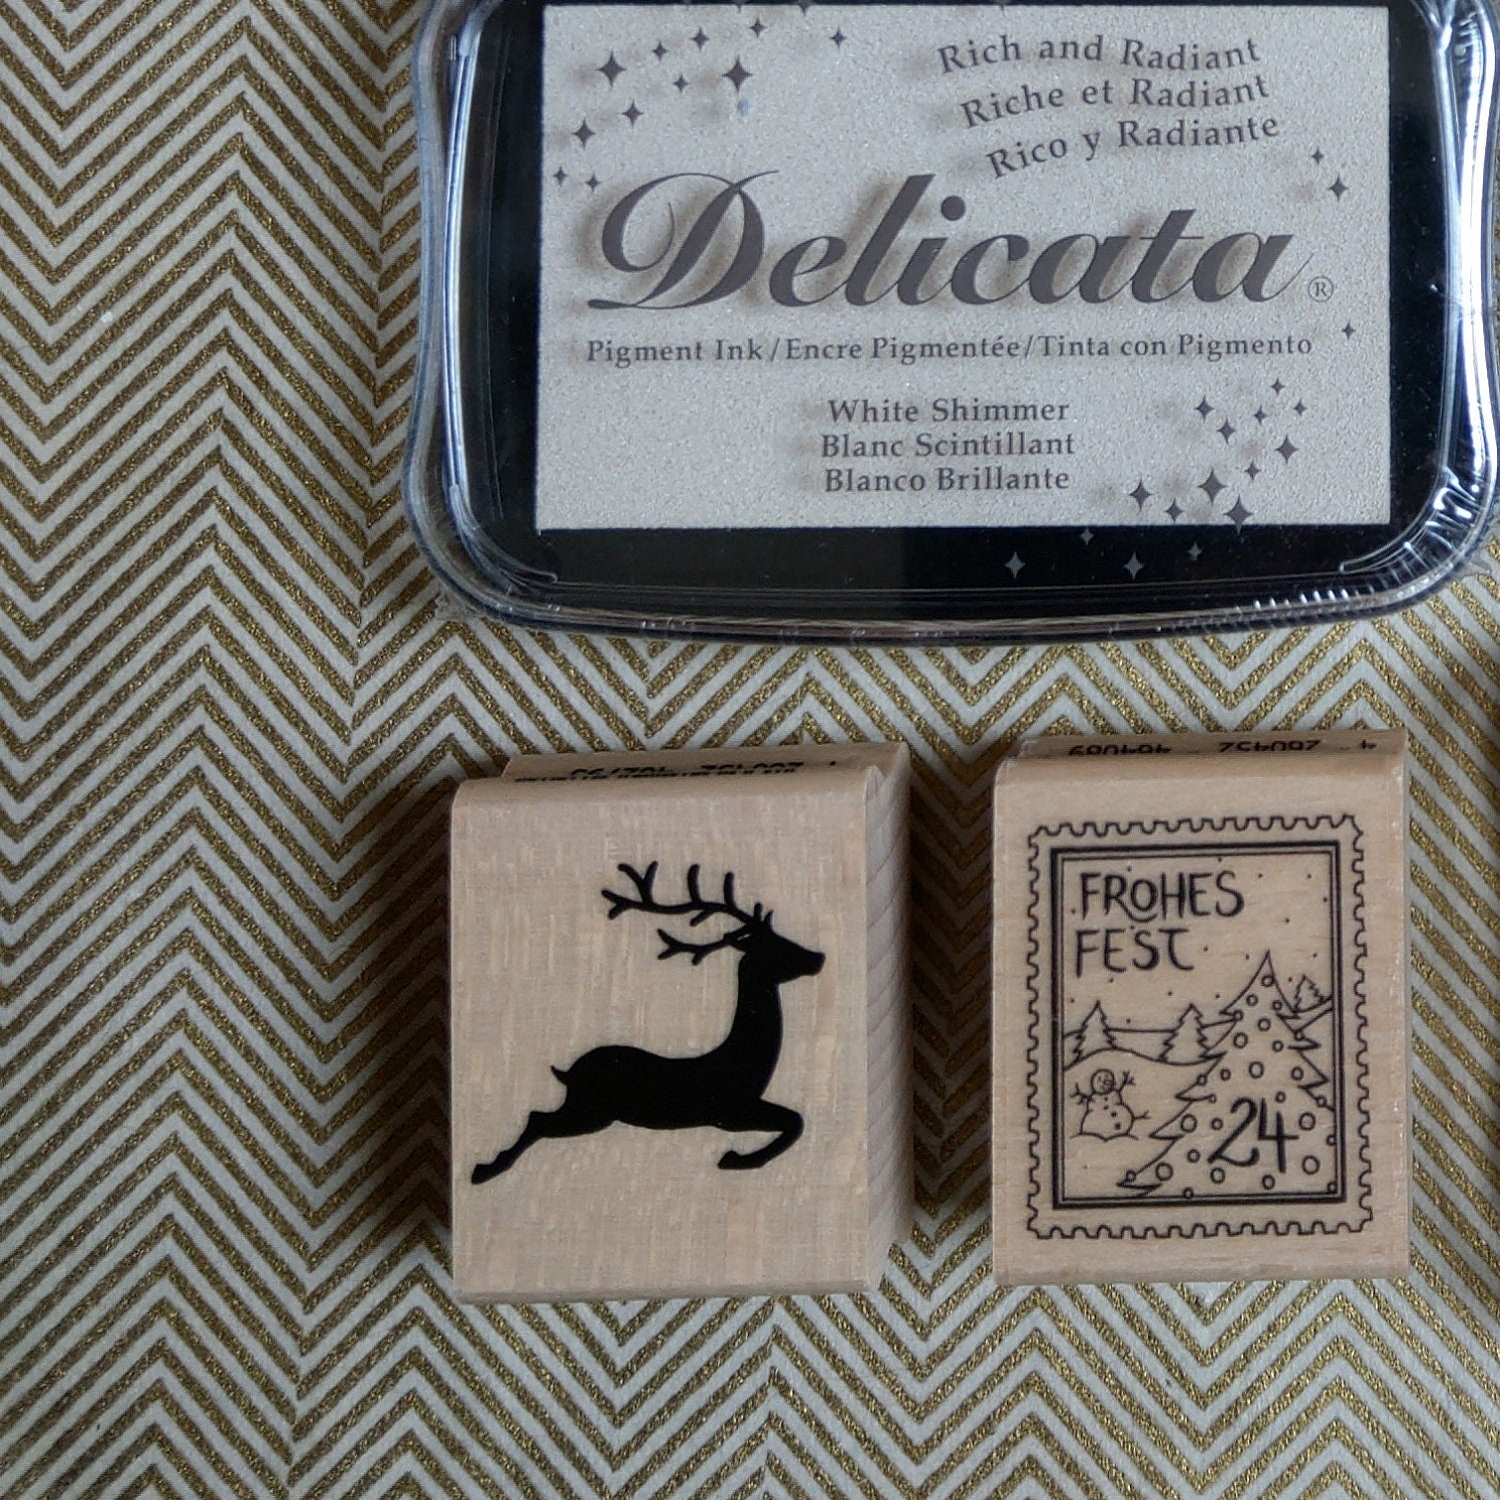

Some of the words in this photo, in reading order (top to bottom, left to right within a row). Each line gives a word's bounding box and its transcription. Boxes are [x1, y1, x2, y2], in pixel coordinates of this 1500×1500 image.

[937, 35, 1022, 74] Rich
[1038, 35, 1104, 62] and
[1120, 37, 1261, 70] Radiant
[960, 84, 1065, 129] Riche
[1081, 80, 1114, 105] et
[1130, 74, 1270, 108] Radiant
[986, 136, 1068, 179] Rico
[1082, 131, 1101, 161] y
[1117, 117, 1280, 148] Radiante
[587, 339, 702, 368] Pigment
[1120, 340, 1167, 357] con
[1177, 333, 1313, 362] Pigmento
[828, 399, 919, 423] White
[932, 398, 1070, 423] Shimmer
[821, 433, 903, 458] Blanc
[915, 431, 1076, 457] Scintillant
[825, 468, 926, 492] Blanco
[937, 466, 1070, 491] Brillante
[1079, 871, 1245, 922] FROHES
[1075, 927, 1195, 978] FEST
[1207, 1097, 1298, 1173] 24
